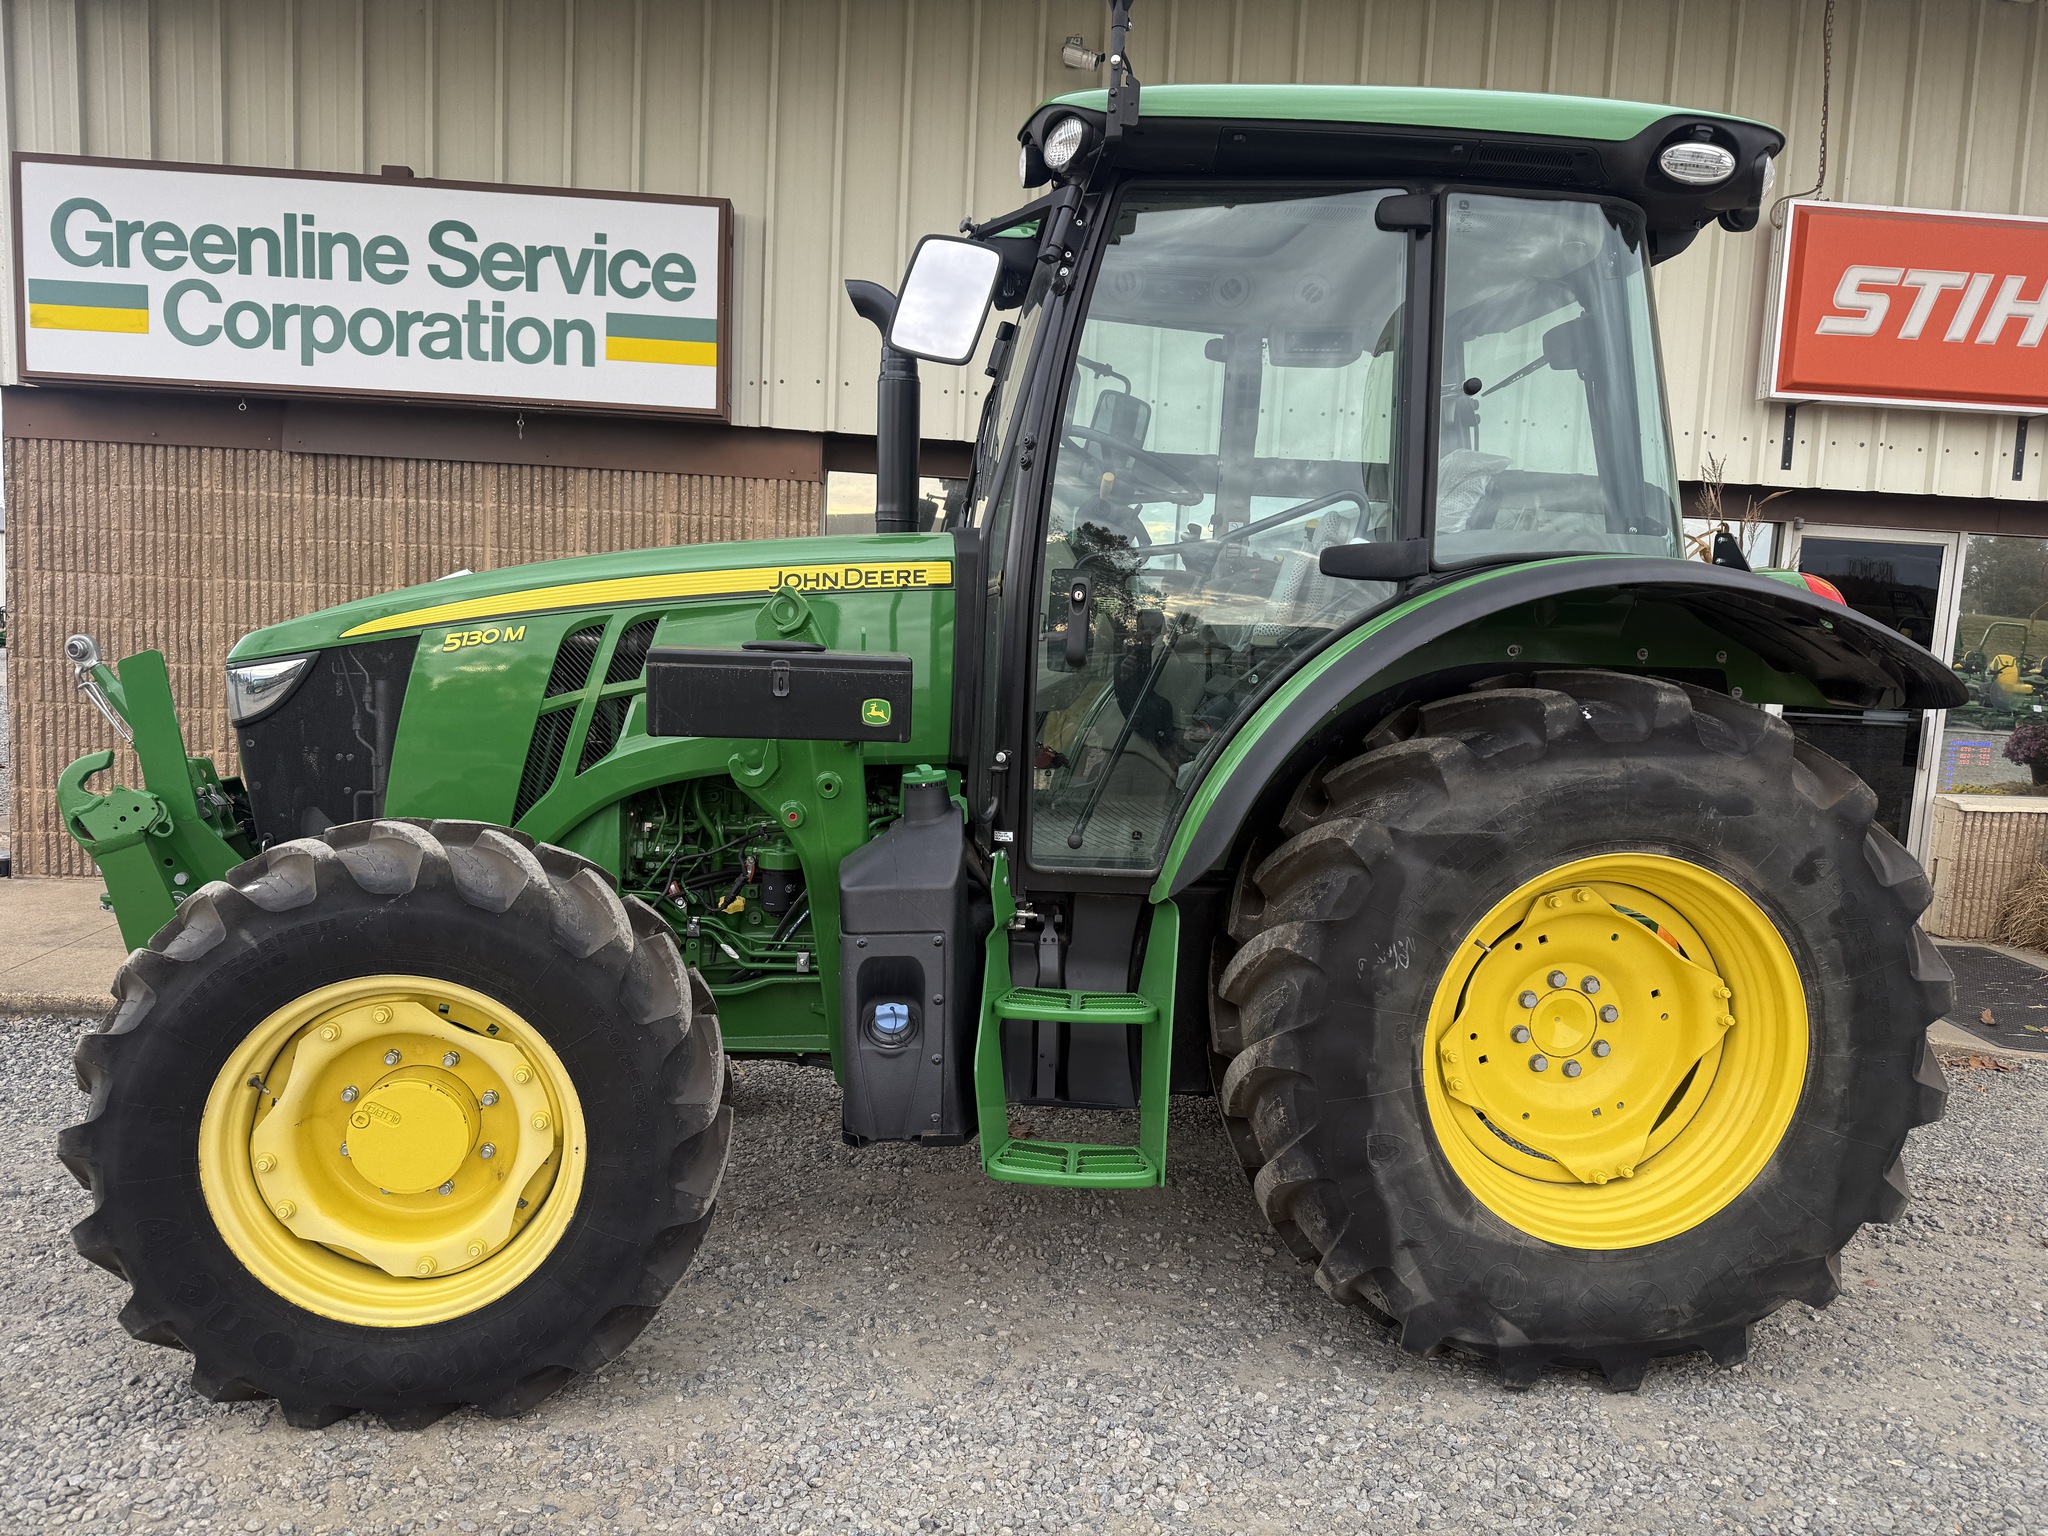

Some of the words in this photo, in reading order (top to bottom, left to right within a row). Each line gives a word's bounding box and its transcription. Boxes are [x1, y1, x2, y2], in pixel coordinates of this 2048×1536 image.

[49, 196, 410, 285] Greenline
[427, 219, 698, 303] Service
[162, 277, 596, 368] Corporation
[1814, 264, 2048, 348] STIH
[769, 570, 839, 590] JOHN
[844, 568, 927, 587] DEERE
[442, 628, 501, 653] 5130
[503, 625, 527, 643] M
[1390, 776, 1608, 928] PERFORMER
[178, 918, 338, 1014] PERFORMER
[233, 951, 290, 987] EVO
[588, 1003, 651, 1132] 320/85R24
[1400, 1196, 1790, 1334] Firestone
[173, 1271, 552, 1393] Firestone
